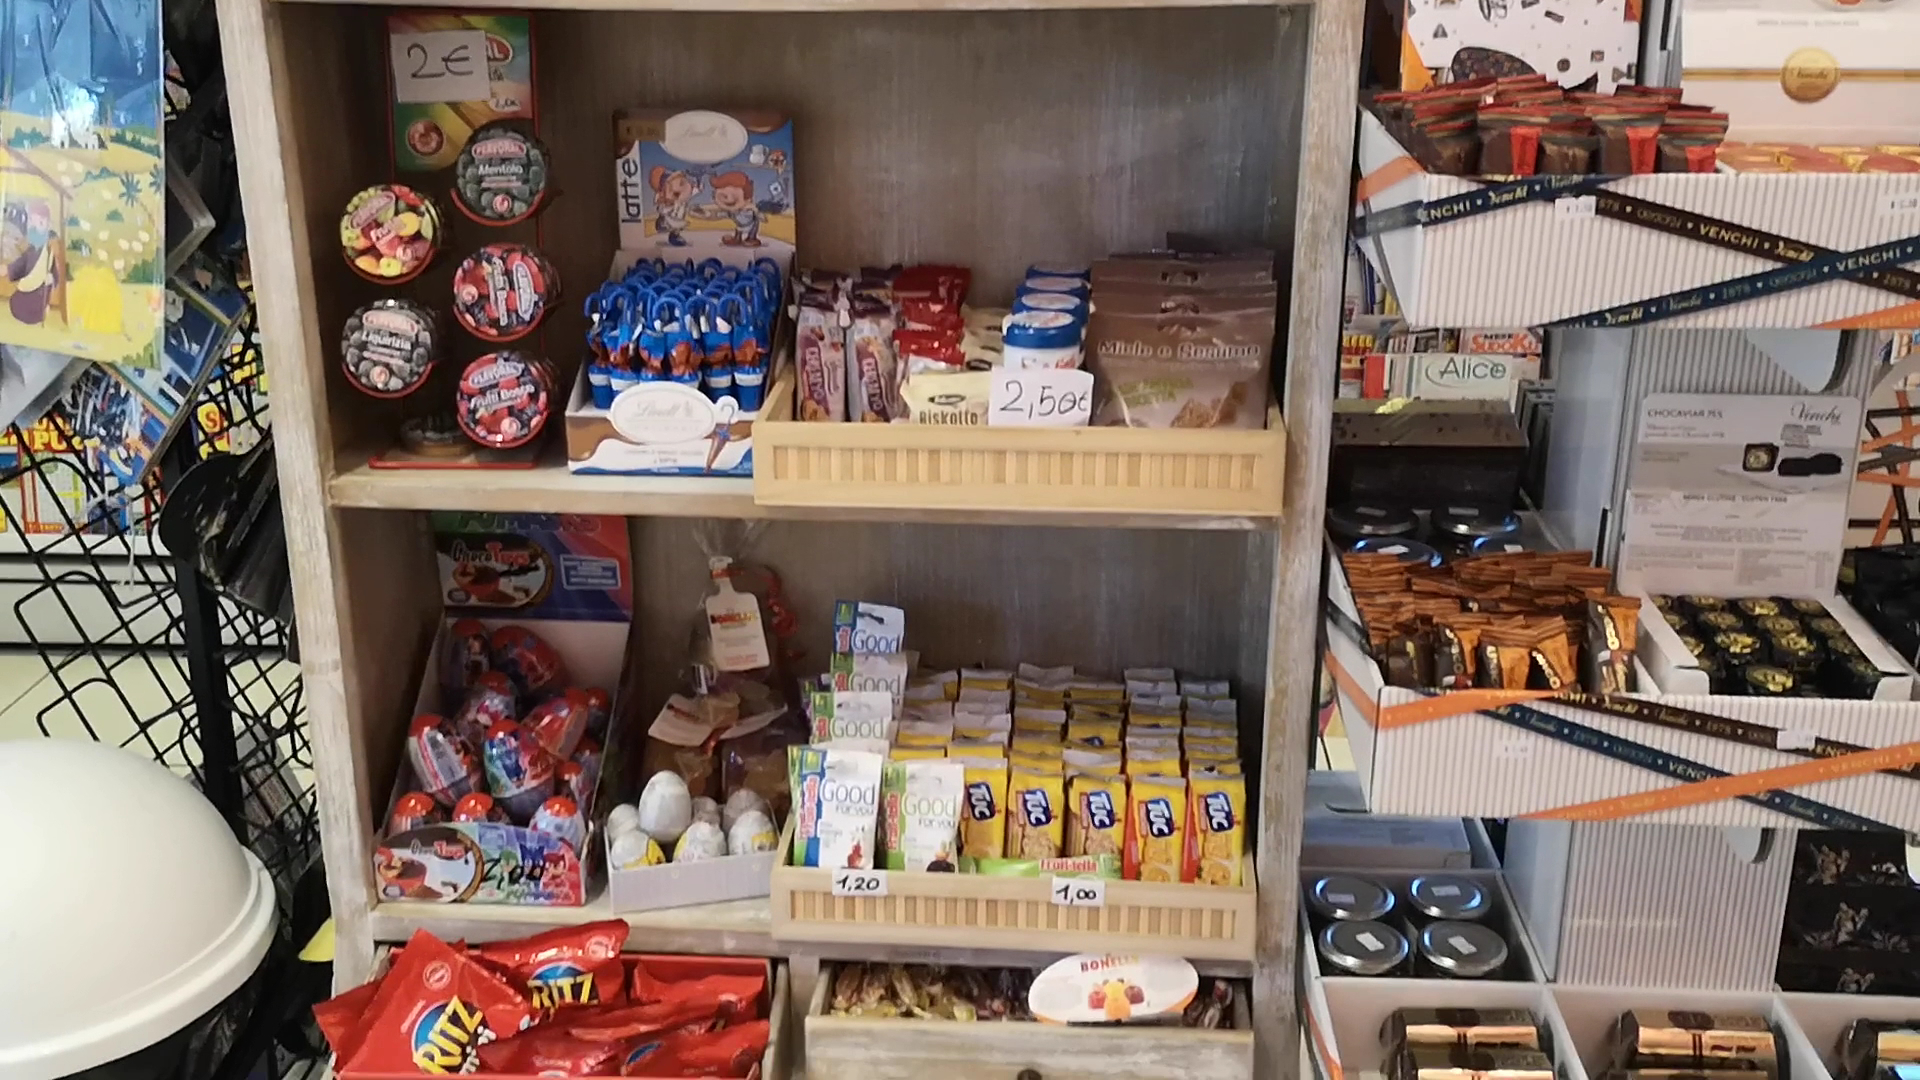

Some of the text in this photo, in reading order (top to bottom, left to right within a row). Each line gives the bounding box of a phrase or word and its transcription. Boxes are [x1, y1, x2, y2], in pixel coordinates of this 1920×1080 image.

[407, 43, 473, 79] 2€
[620, 158, 642, 223] latte
[1700, 224, 1760, 249] VENCHI
[1836, 248, 1901, 272] VENCHI
[1440, 355, 1507, 380] Alice
[852, 628, 900, 653] Good
[850, 673, 900, 696] Good
[832, 718, 884, 739] Good
[822, 778, 876, 806] Good
[904, 795, 958, 818] Good
[836, 875, 880, 892] 1,20
[1056, 884, 1097, 905] 1,00
[527, 972, 597, 1011] RITZ
[413, 995, 483, 1075] RITZ
